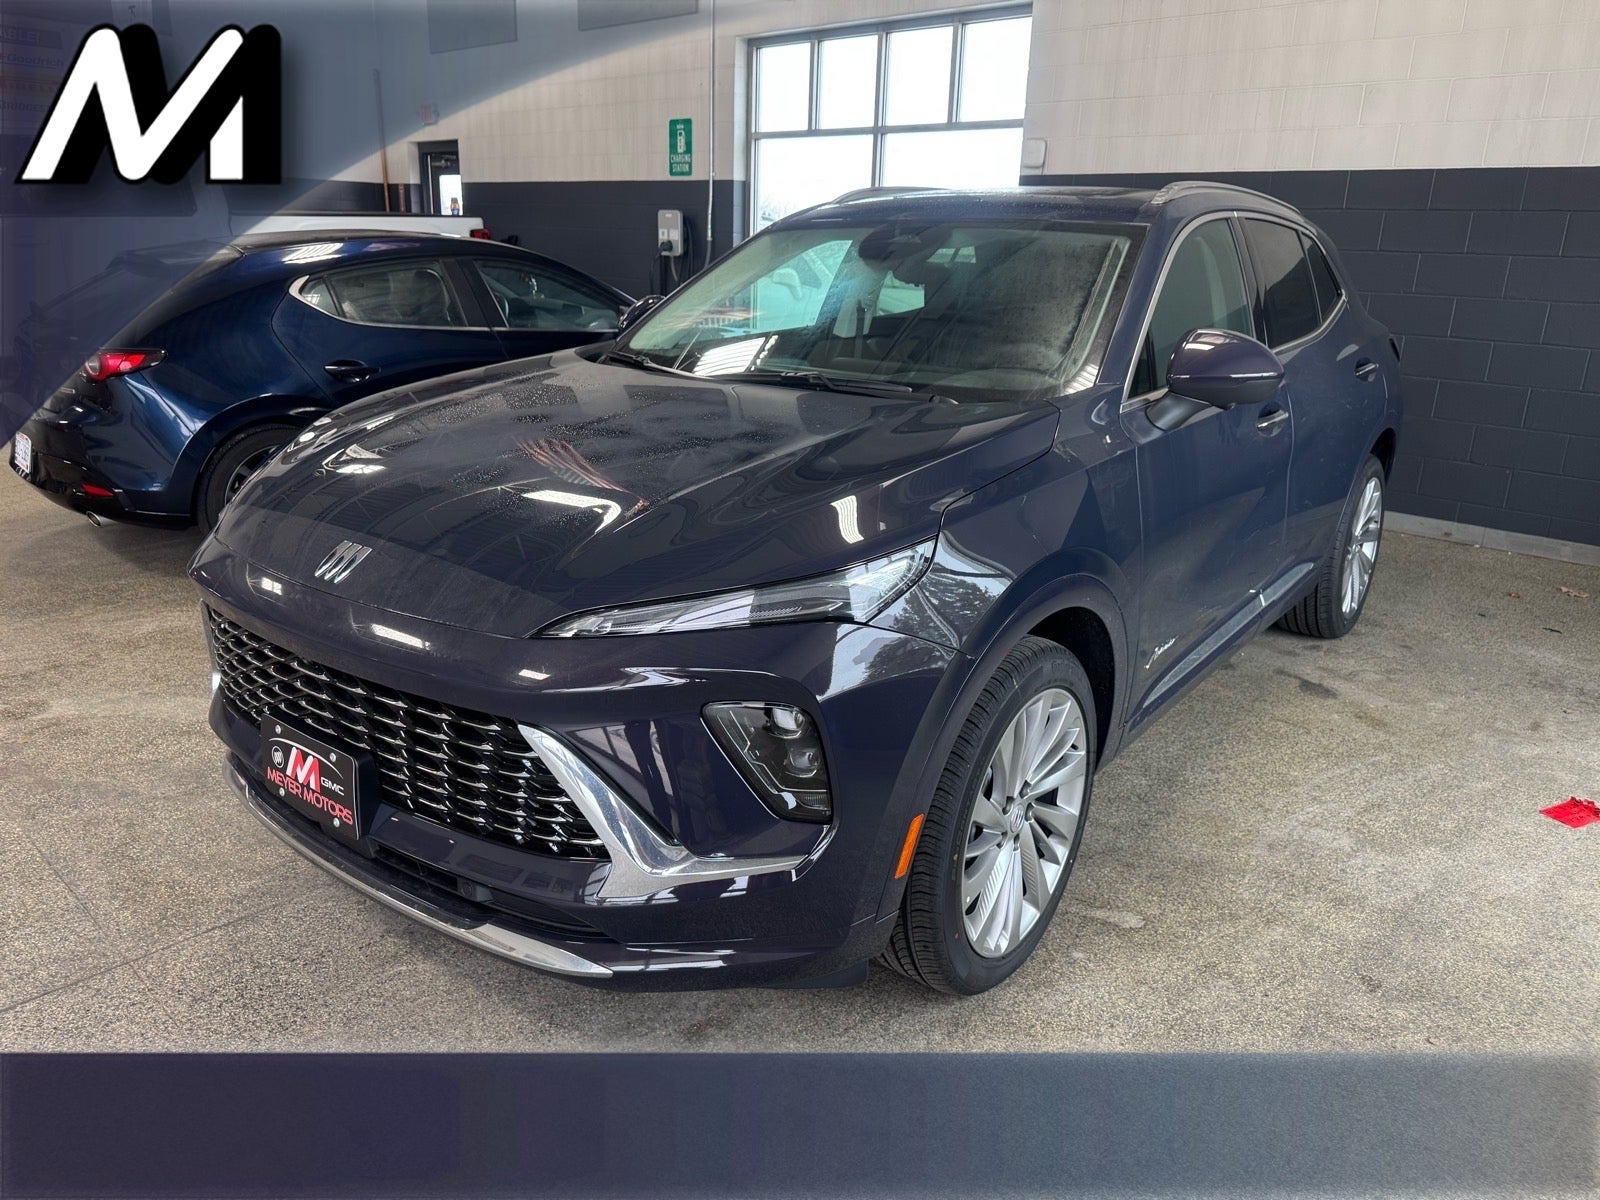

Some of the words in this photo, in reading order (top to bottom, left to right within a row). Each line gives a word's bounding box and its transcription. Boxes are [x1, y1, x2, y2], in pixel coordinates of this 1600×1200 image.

[670, 153, 691, 163] CHARGING
[672, 163, 689, 172] STATION
[320, 776, 344, 796] GMC
[267, 766, 302, 798] MEYER
[303, 786, 353, 825] MOTORS
